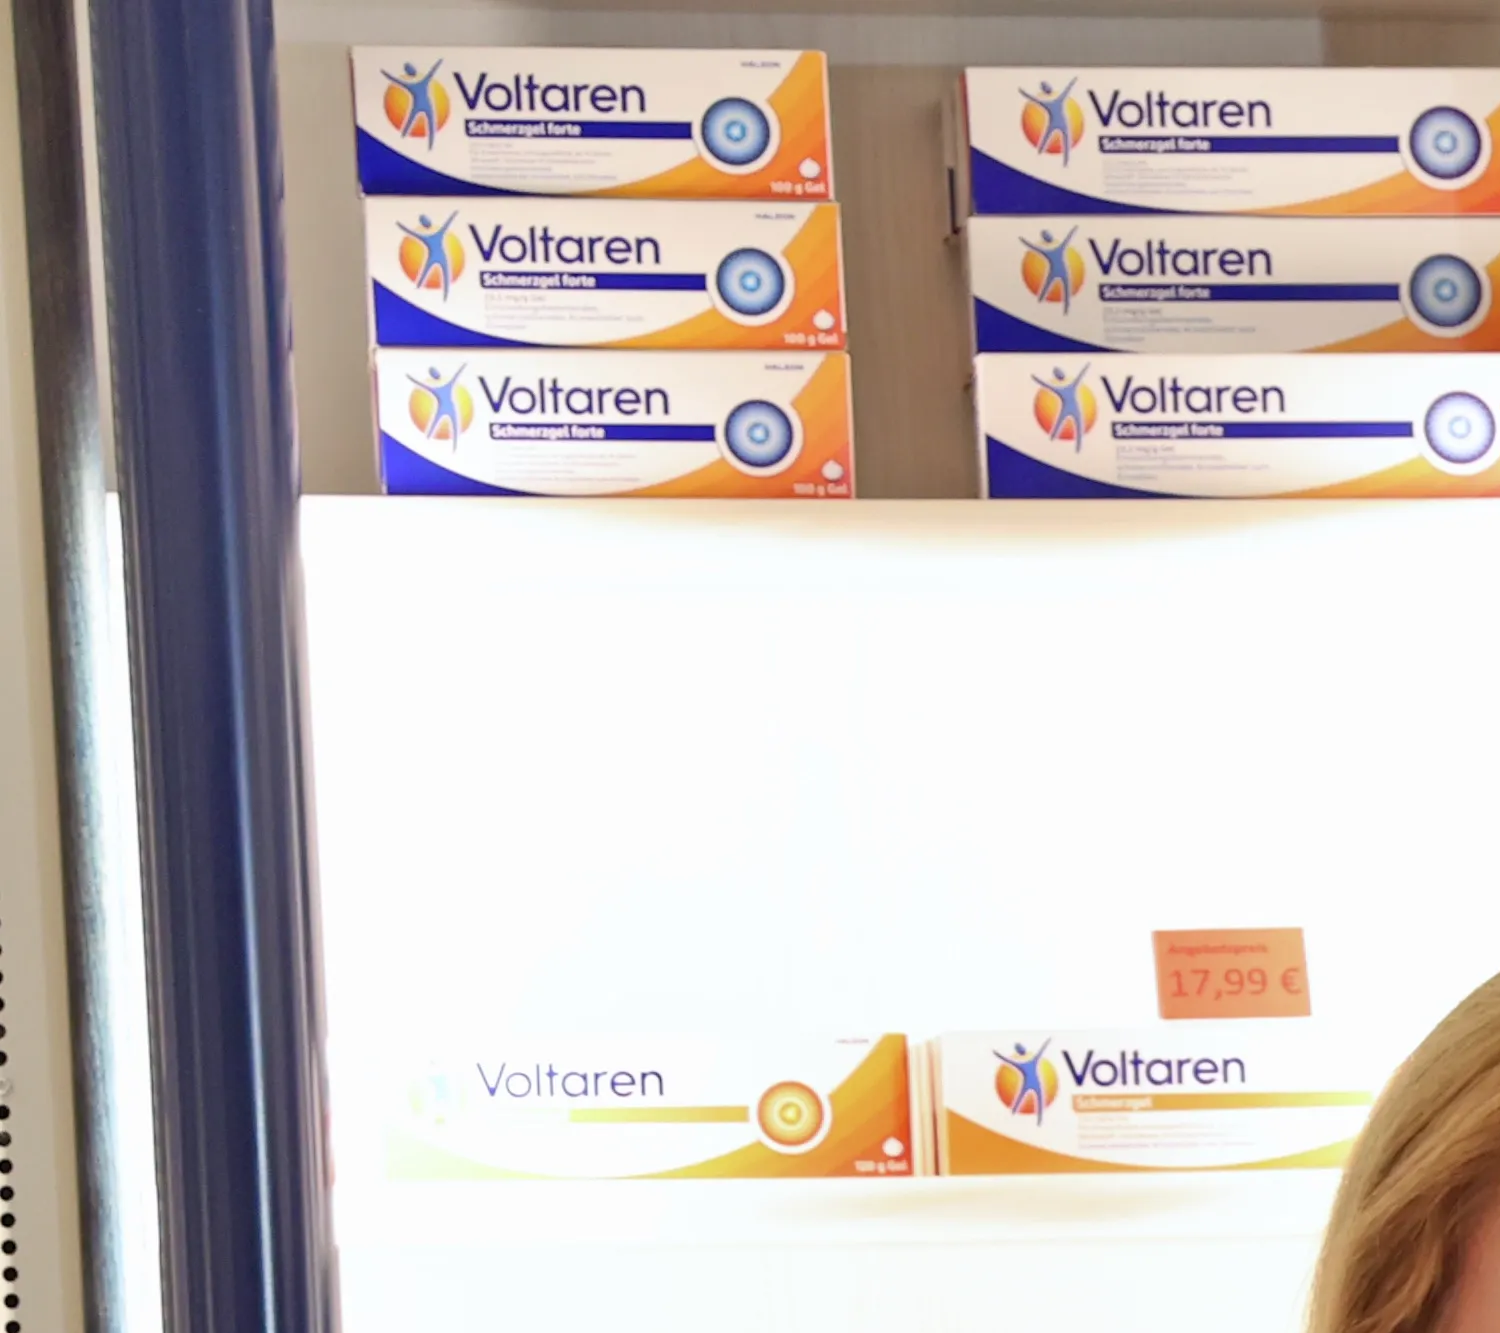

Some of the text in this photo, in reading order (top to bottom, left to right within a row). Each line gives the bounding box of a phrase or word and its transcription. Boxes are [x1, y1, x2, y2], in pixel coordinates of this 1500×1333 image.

[453, 72, 645, 112] Voltaren
[1087, 90, 1272, 129] Voltaren
[469, 224, 660, 264] Voltaren
[1088, 238, 1273, 277] Voltaren
[478, 376, 669, 415] Voltaren
[1100, 375, 1286, 415] Voltaren
[1169, 967, 1303, 1001] 17,99 €
[476, 1061, 665, 1099] Voltaren
[1062, 1049, 1246, 1089] Voltaren
